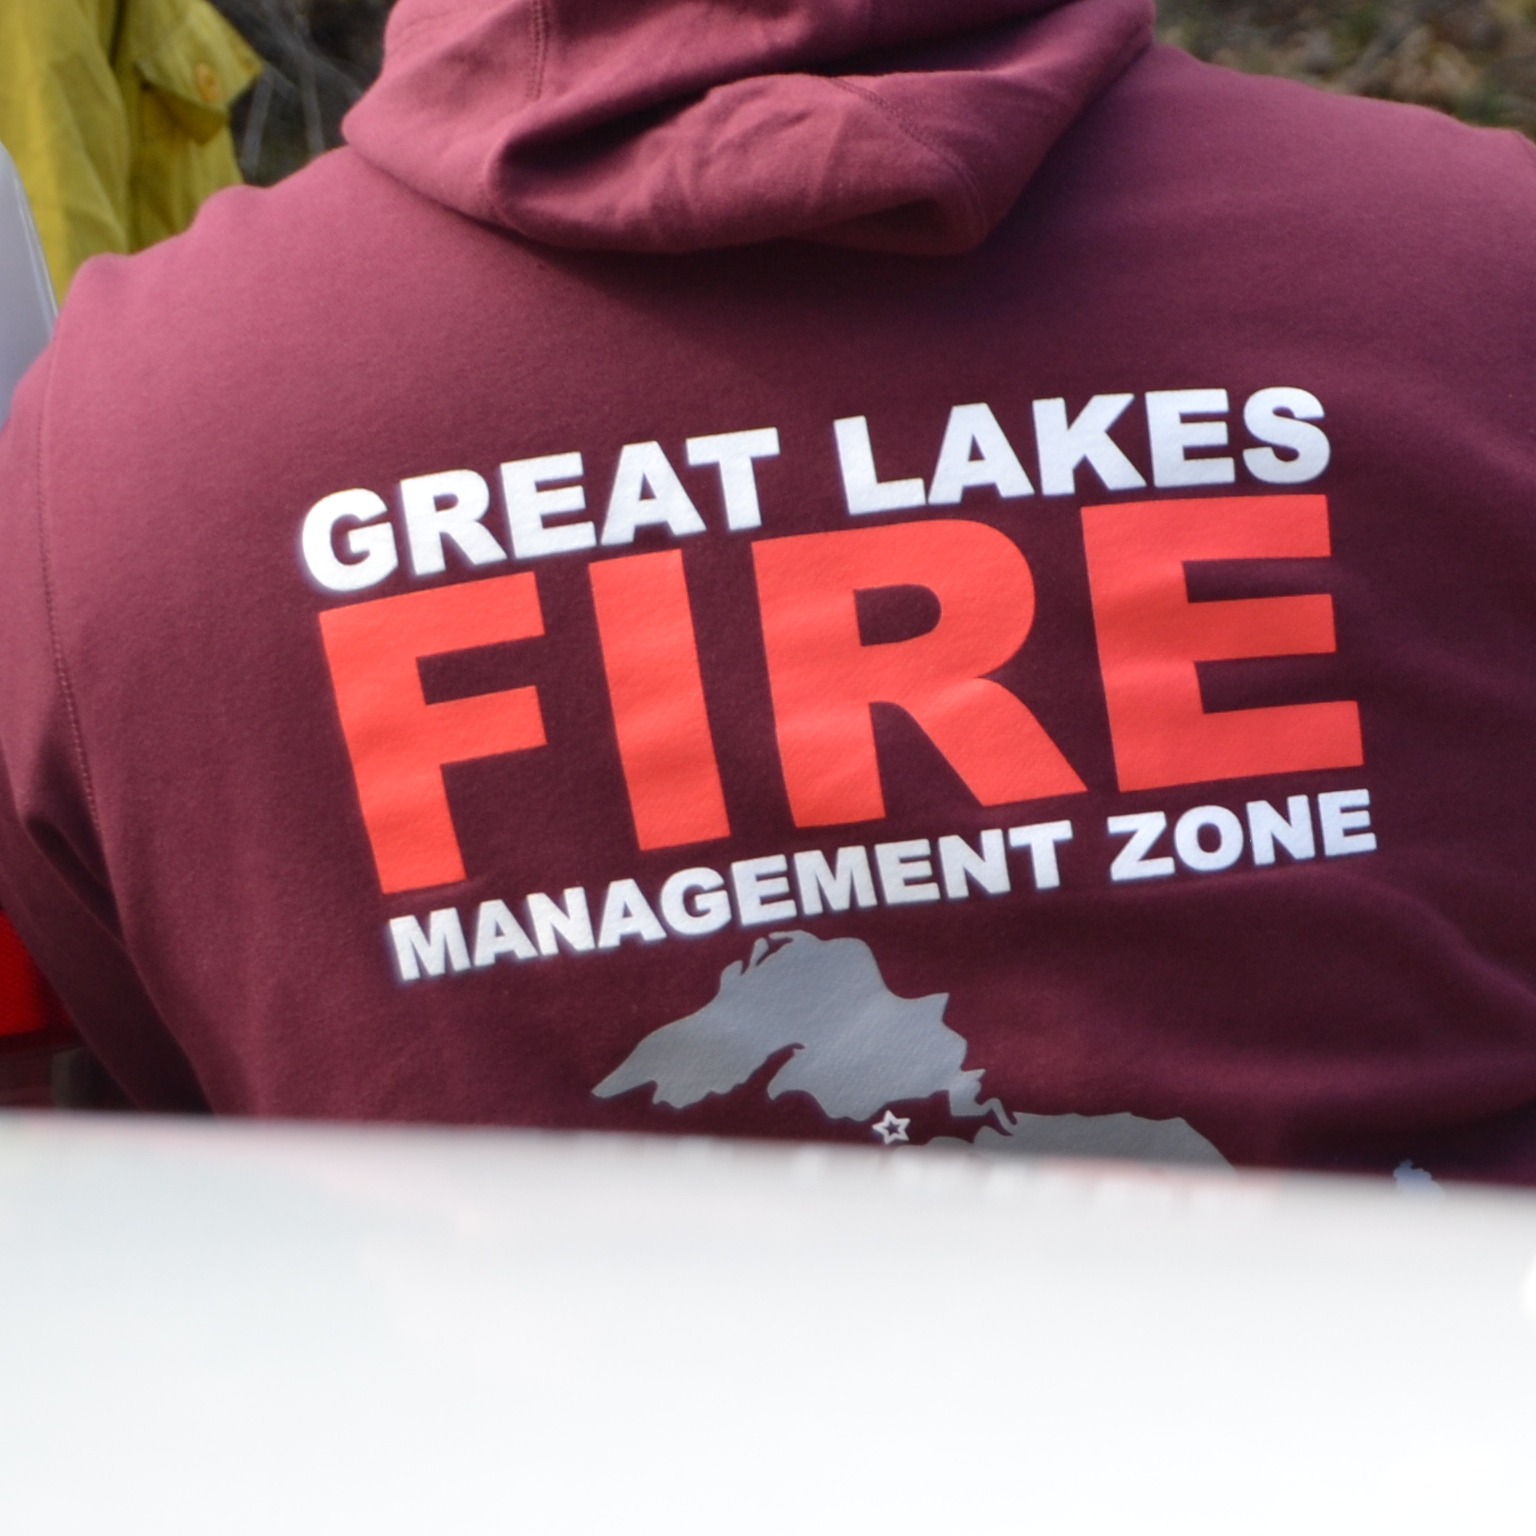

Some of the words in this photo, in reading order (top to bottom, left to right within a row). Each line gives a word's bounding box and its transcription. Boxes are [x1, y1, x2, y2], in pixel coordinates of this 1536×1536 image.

[299, 427, 780, 592] GREAT
[833, 387, 1331, 515] LAKES
[318, 494, 1364, 895] FIRE
[388, 820, 1073, 981] MANAGEMENT
[1107, 789, 1377, 881] ZONE
